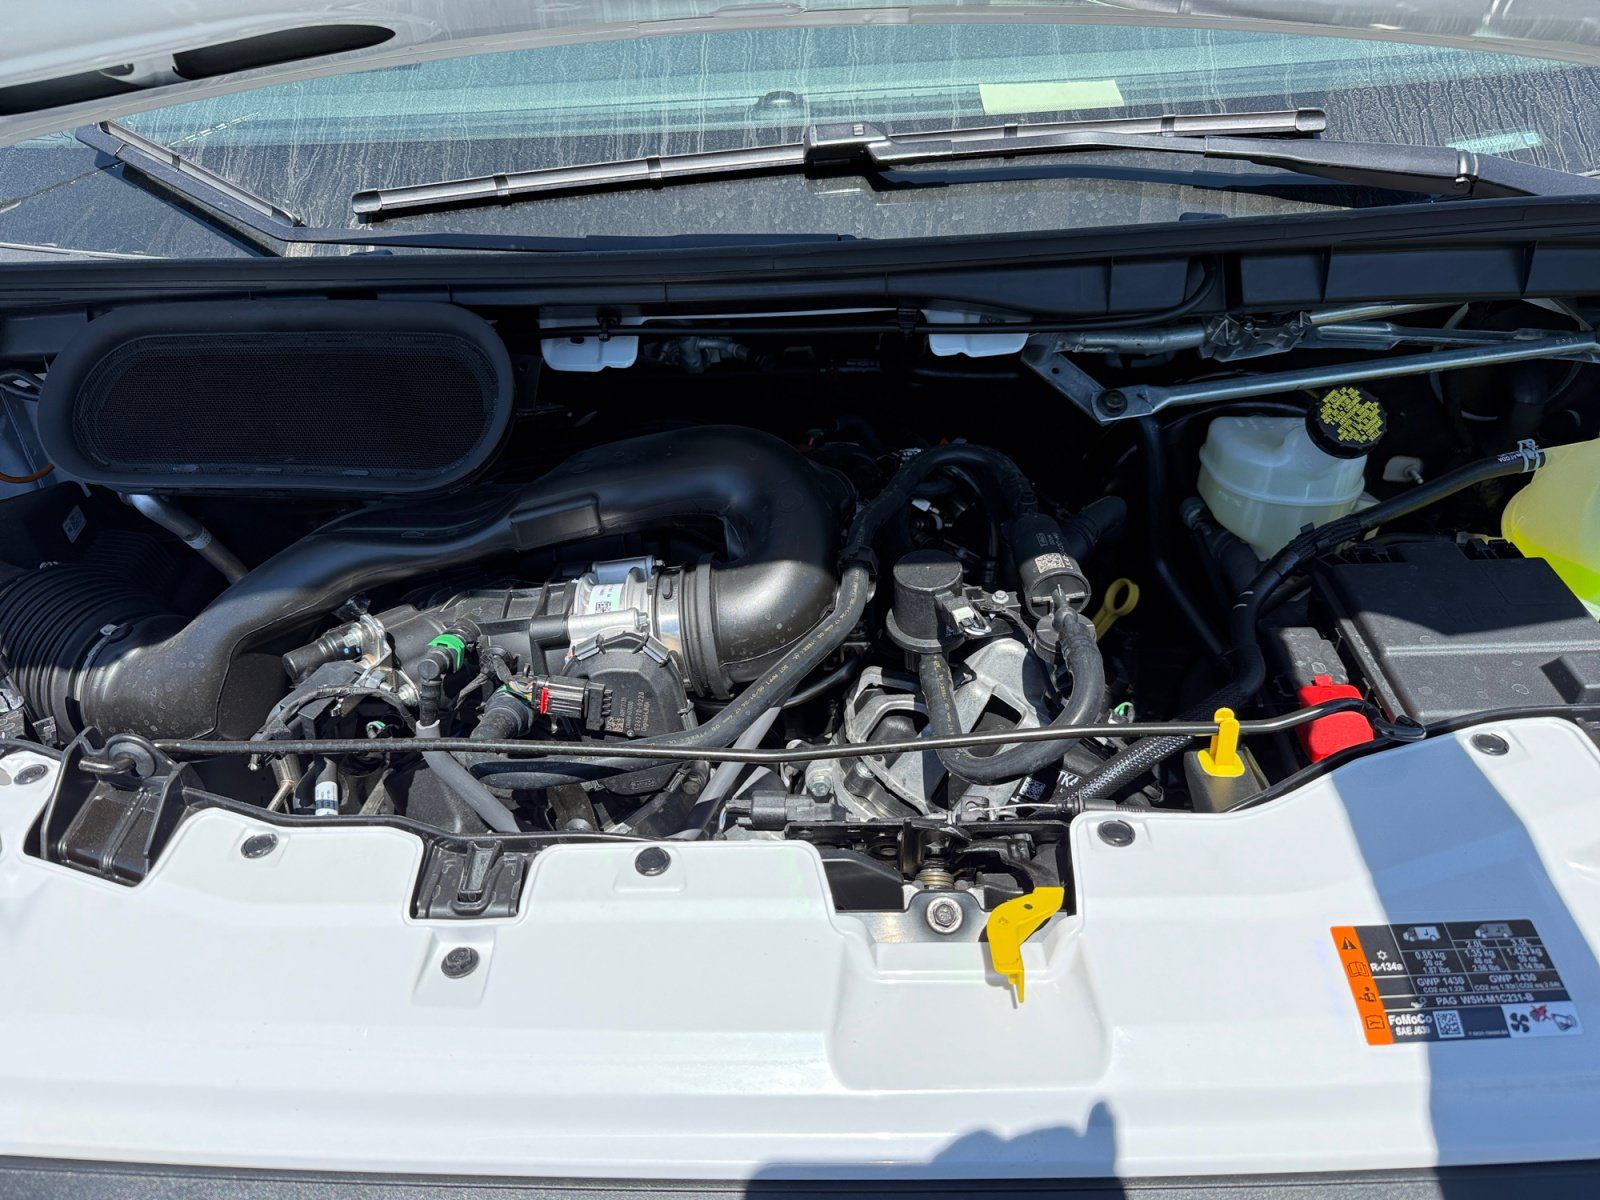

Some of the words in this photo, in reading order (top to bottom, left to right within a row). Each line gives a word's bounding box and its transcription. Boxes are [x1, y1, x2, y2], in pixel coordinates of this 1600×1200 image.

[1433, 951, 1447, 962] kg
[1482, 948, 1497, 959] kg
[1529, 946, 1543, 957] kg
[1370, 962, 1404, 972] R-134a
[1417, 977, 1441, 987] GWP
[1442, 976, 1465, 985] 1430
[1488, 973, 1512, 983] GWP
[1513, 973, 1538, 982] 1430
[1435, 996, 1458, 1006] PAG
[1387, 1013, 1433, 1026] FoMoCo
[1395, 1026, 1413, 1036] SAE
